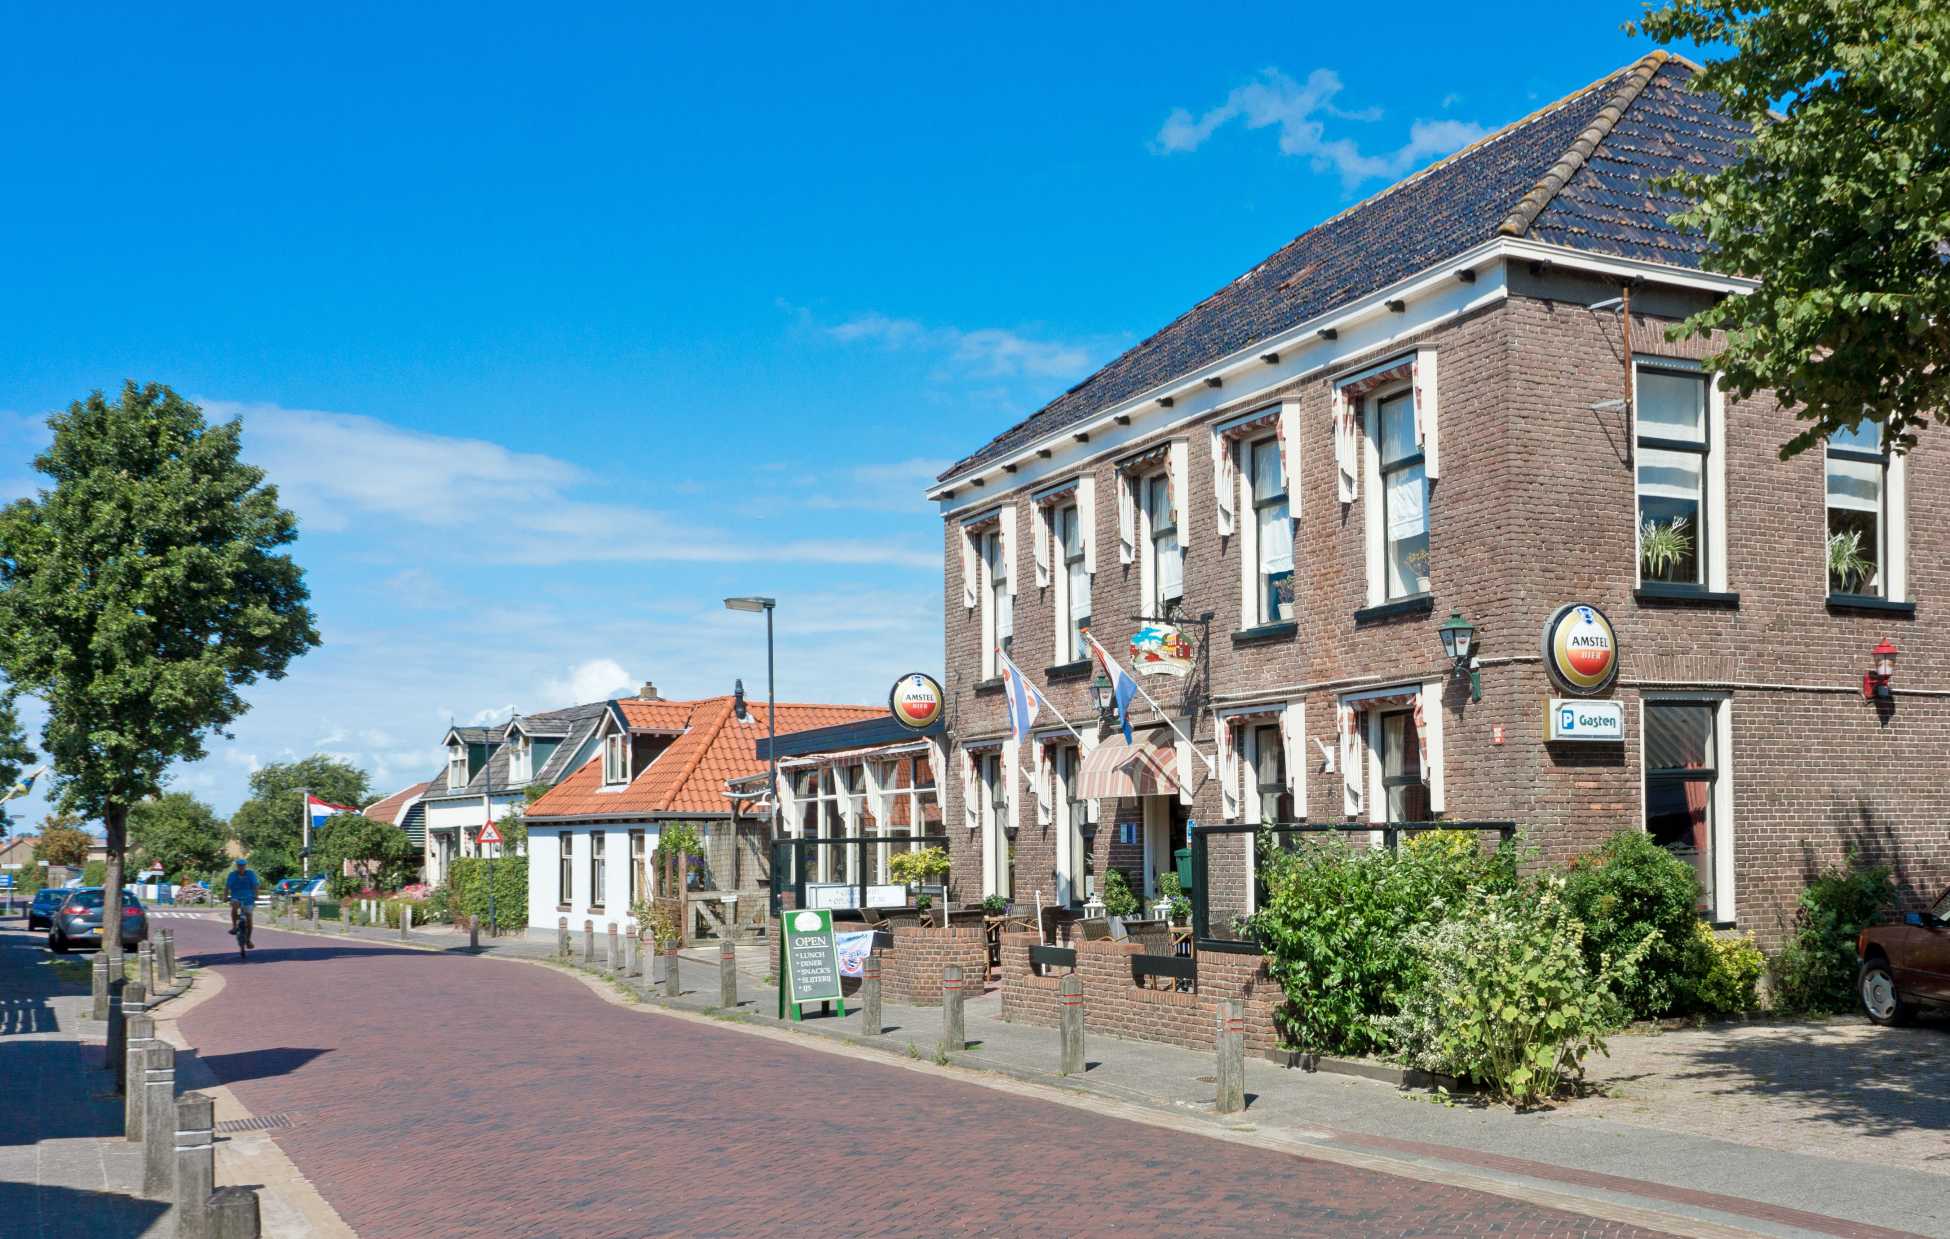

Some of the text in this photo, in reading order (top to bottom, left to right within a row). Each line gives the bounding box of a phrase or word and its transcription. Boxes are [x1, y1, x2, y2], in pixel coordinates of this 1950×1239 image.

[1571, 636, 1609, 648] AMSTEL
[1581, 650, 1601, 659] BIER
[905, 693, 934, 701] AMSTEL
[1562, 710, 1617, 729] P Gasten
[795, 936, 826, 947] OPEN
[800, 951, 825, 959] LUNCH
